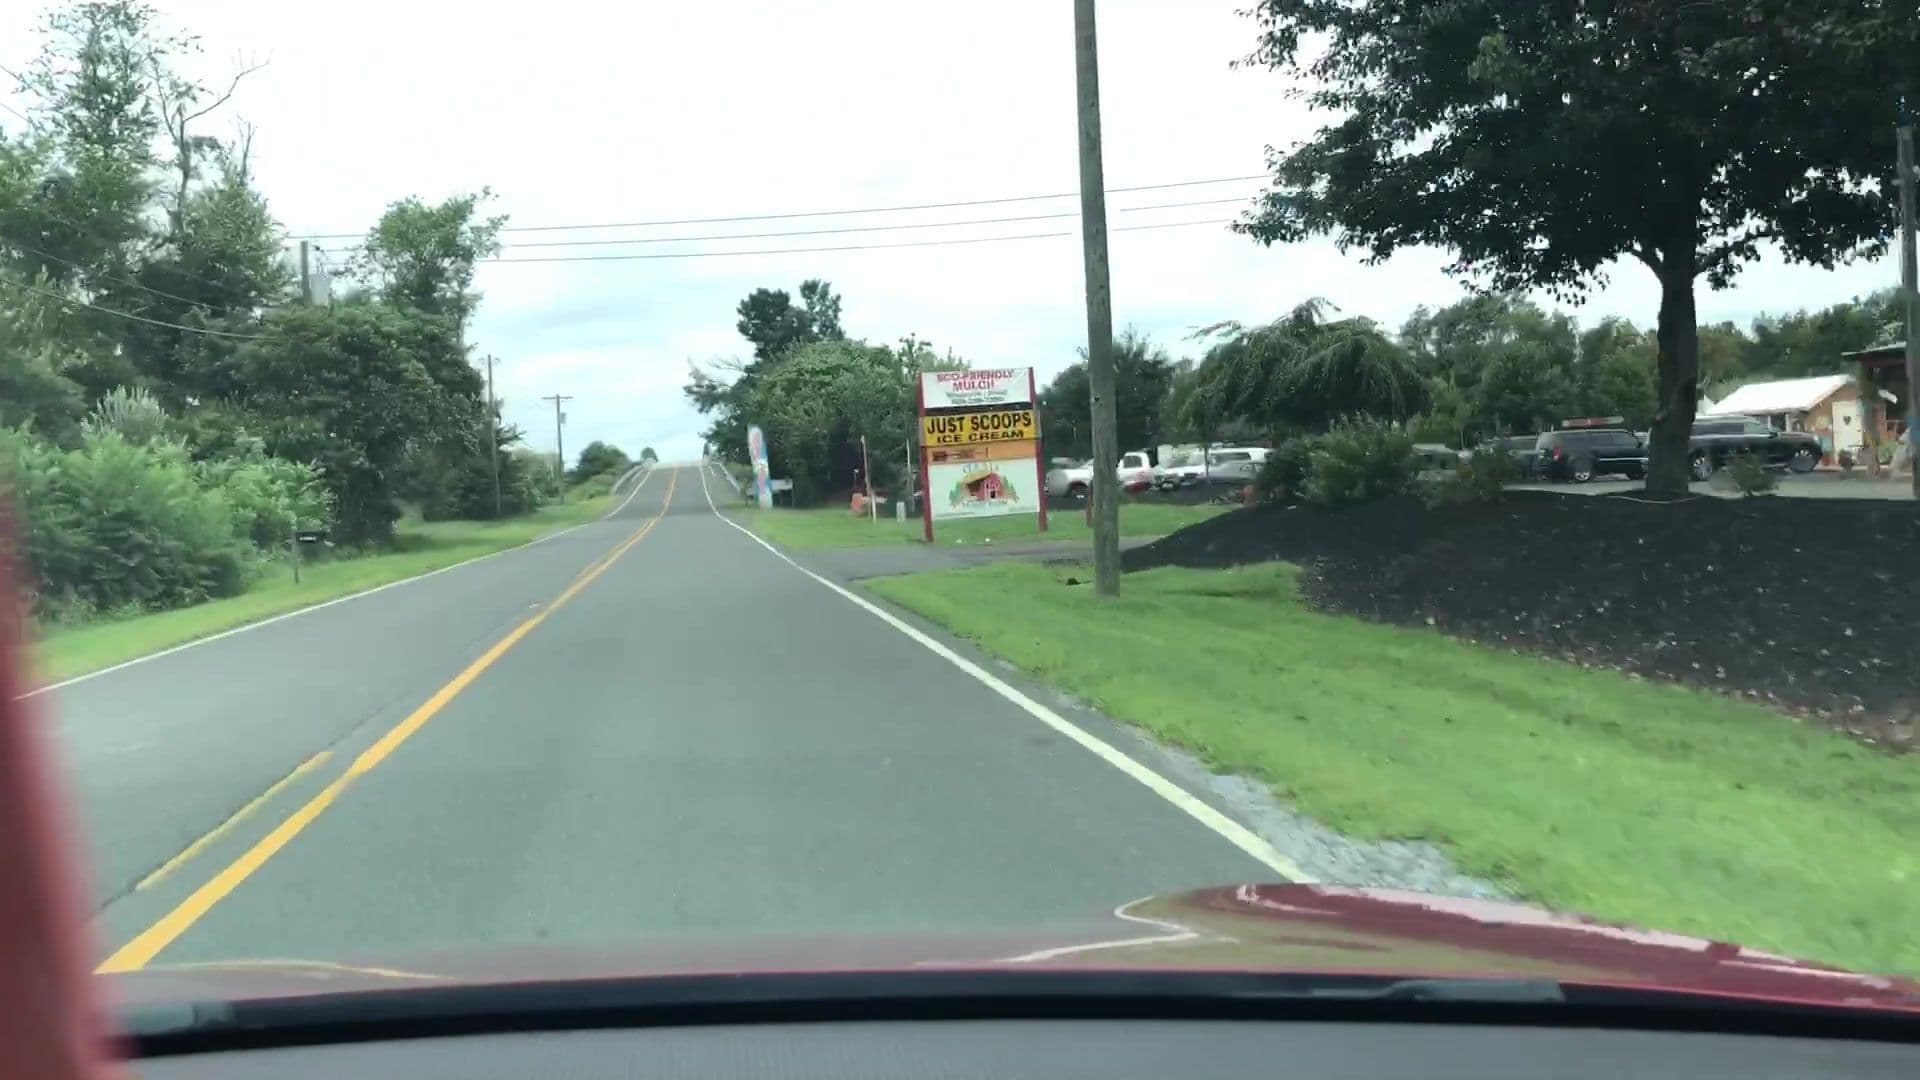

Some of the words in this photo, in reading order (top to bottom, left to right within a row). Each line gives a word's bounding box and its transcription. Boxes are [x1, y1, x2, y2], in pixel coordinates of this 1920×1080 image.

[953, 379, 994, 391] MULCH
[927, 416, 965, 434] JUST
[970, 412, 1032, 431] SCOOPS
[938, 433, 962, 443] ICE
[968, 429, 1024, 441] CREAM
